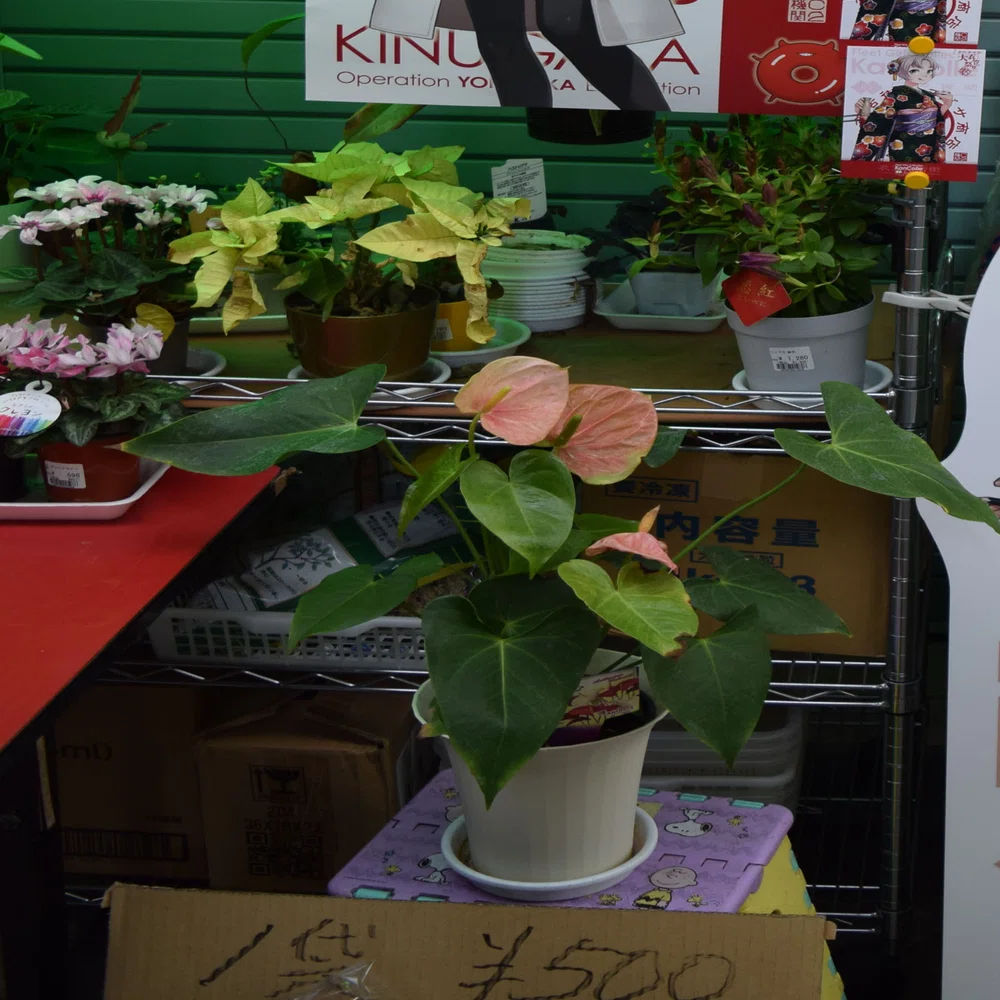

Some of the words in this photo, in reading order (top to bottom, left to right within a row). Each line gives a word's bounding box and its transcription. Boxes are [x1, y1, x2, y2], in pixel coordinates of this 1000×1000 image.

[336, 71, 450, 88] Operation
[655, 510, 821, 548] 内容量
